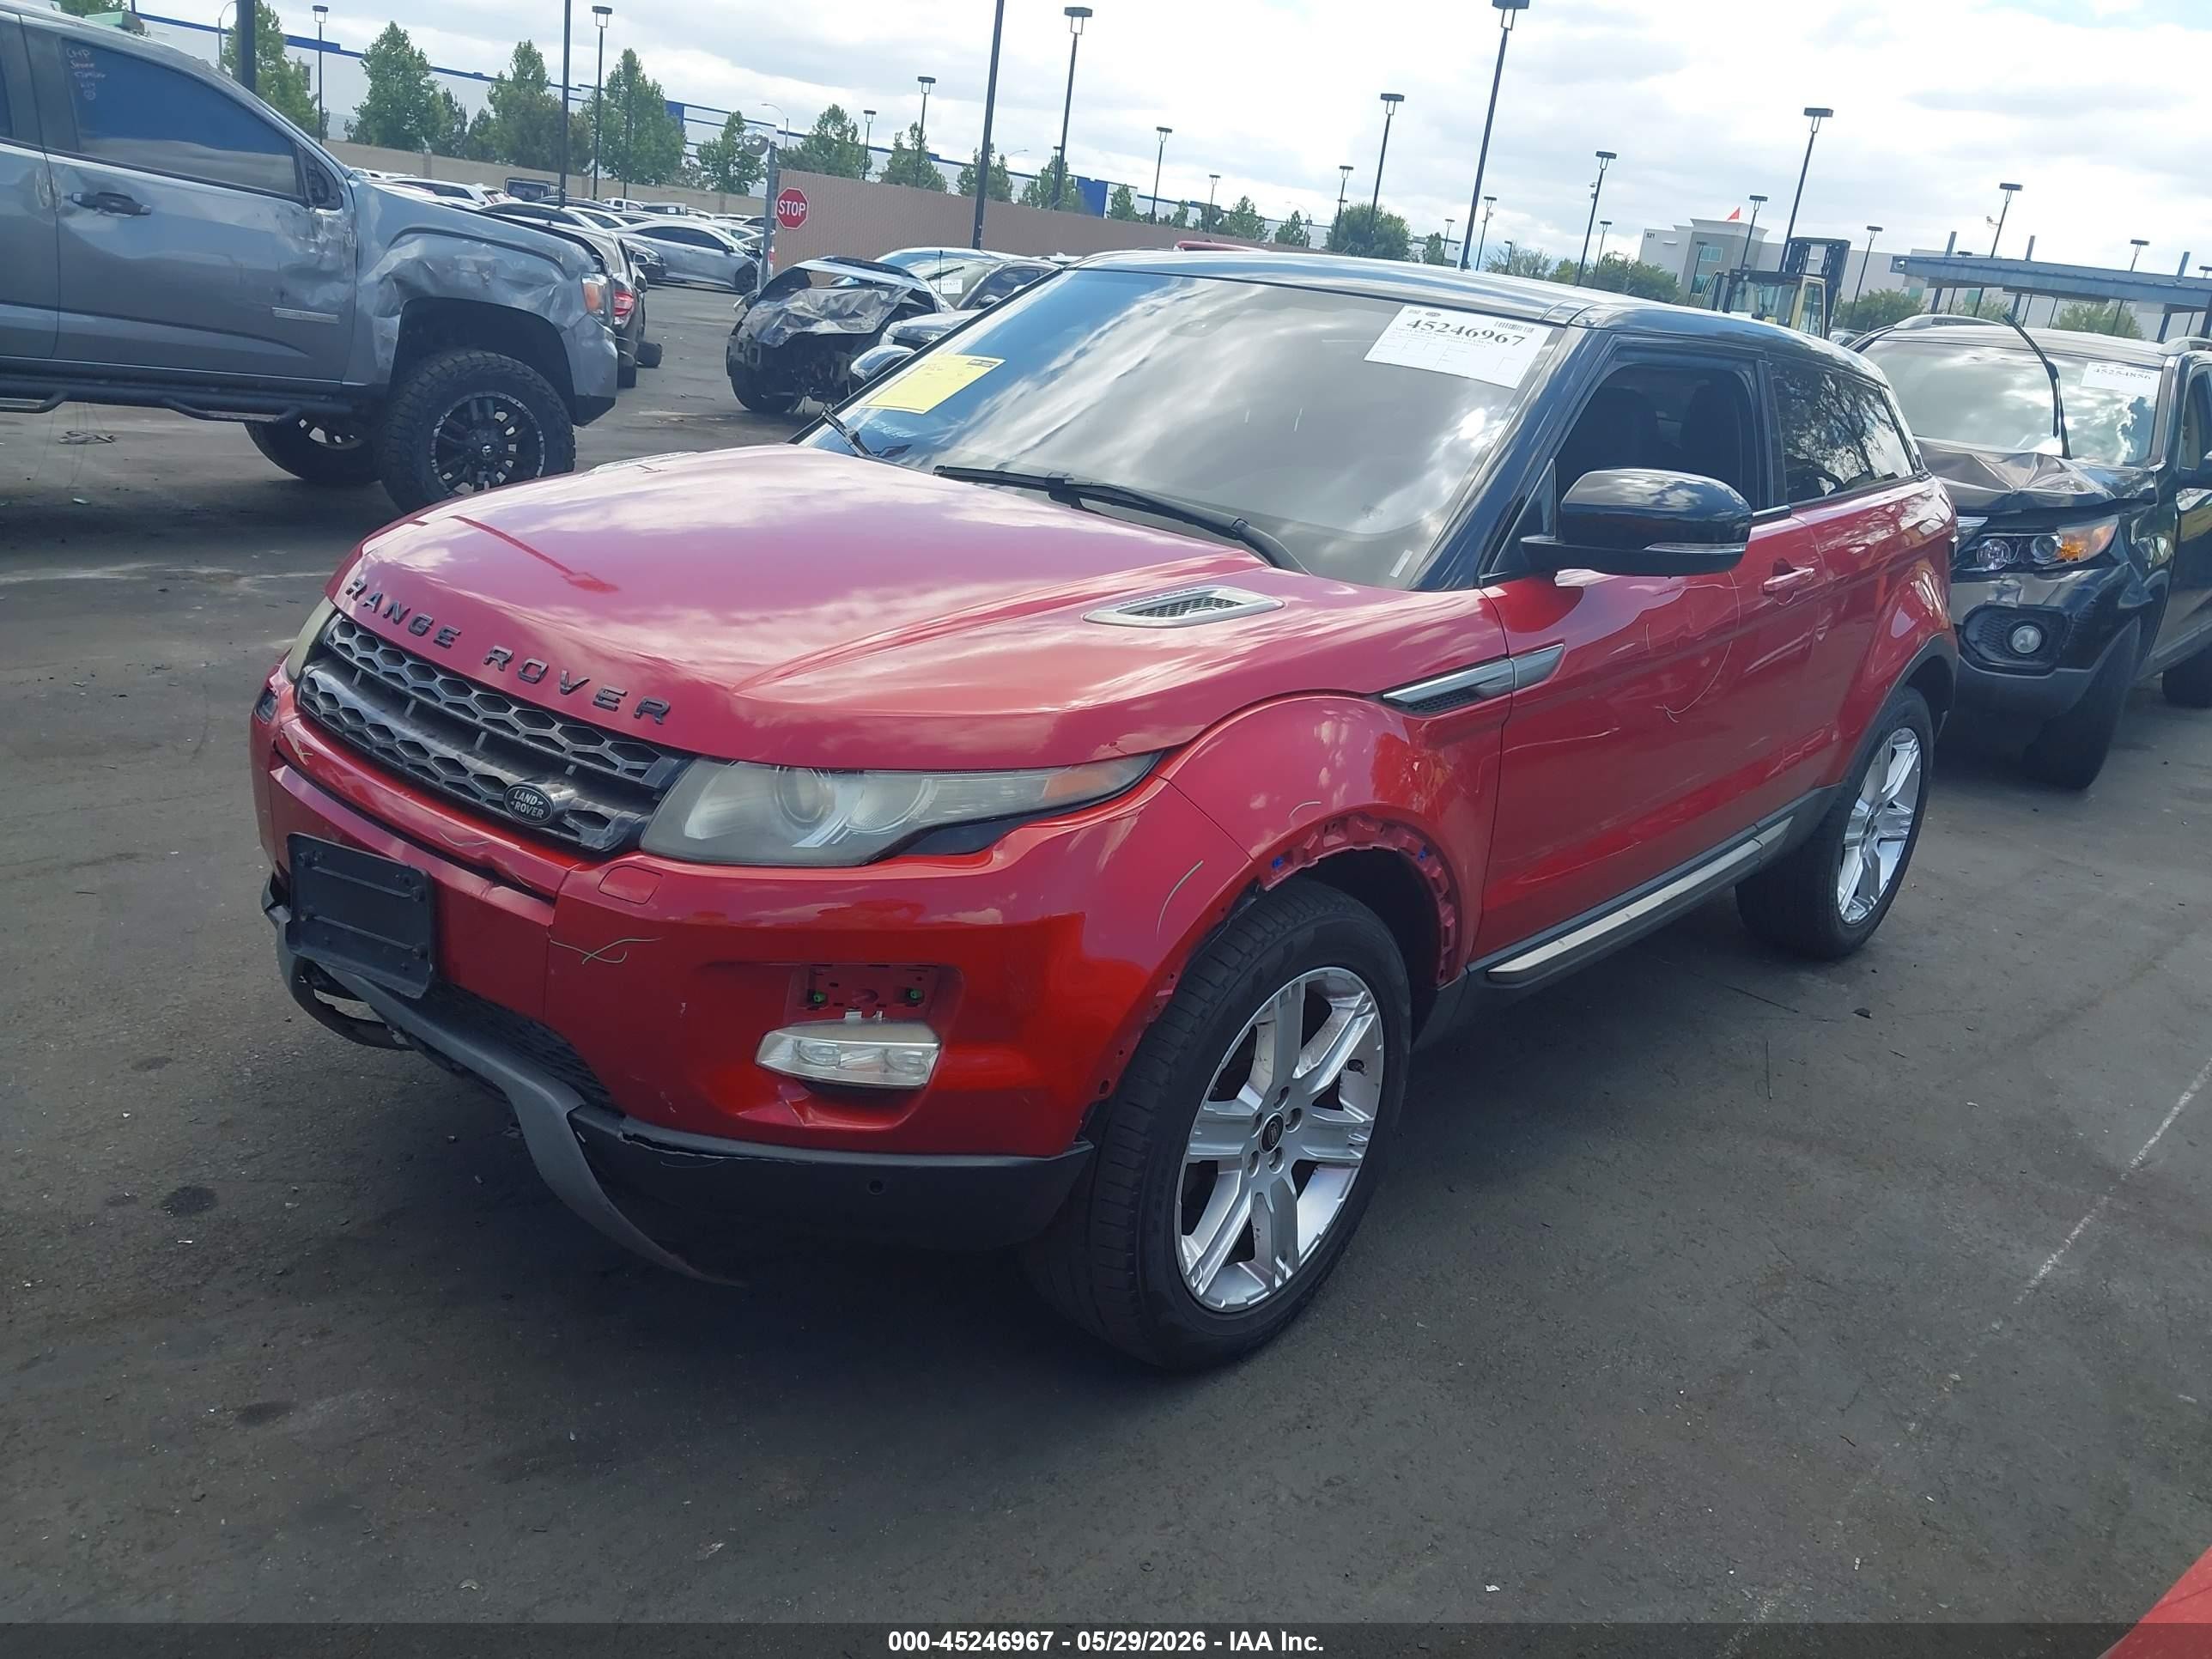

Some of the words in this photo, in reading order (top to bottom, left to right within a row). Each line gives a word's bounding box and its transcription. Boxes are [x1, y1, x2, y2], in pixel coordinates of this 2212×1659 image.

[778, 199, 805, 217] STOP
[1407, 319, 1525, 346] 45246967
[344, 577, 462, 648] RANGE
[483, 644, 671, 726] ROVER
[514, 789, 538, 805] LAND
[514, 800, 544, 819] ROVER
